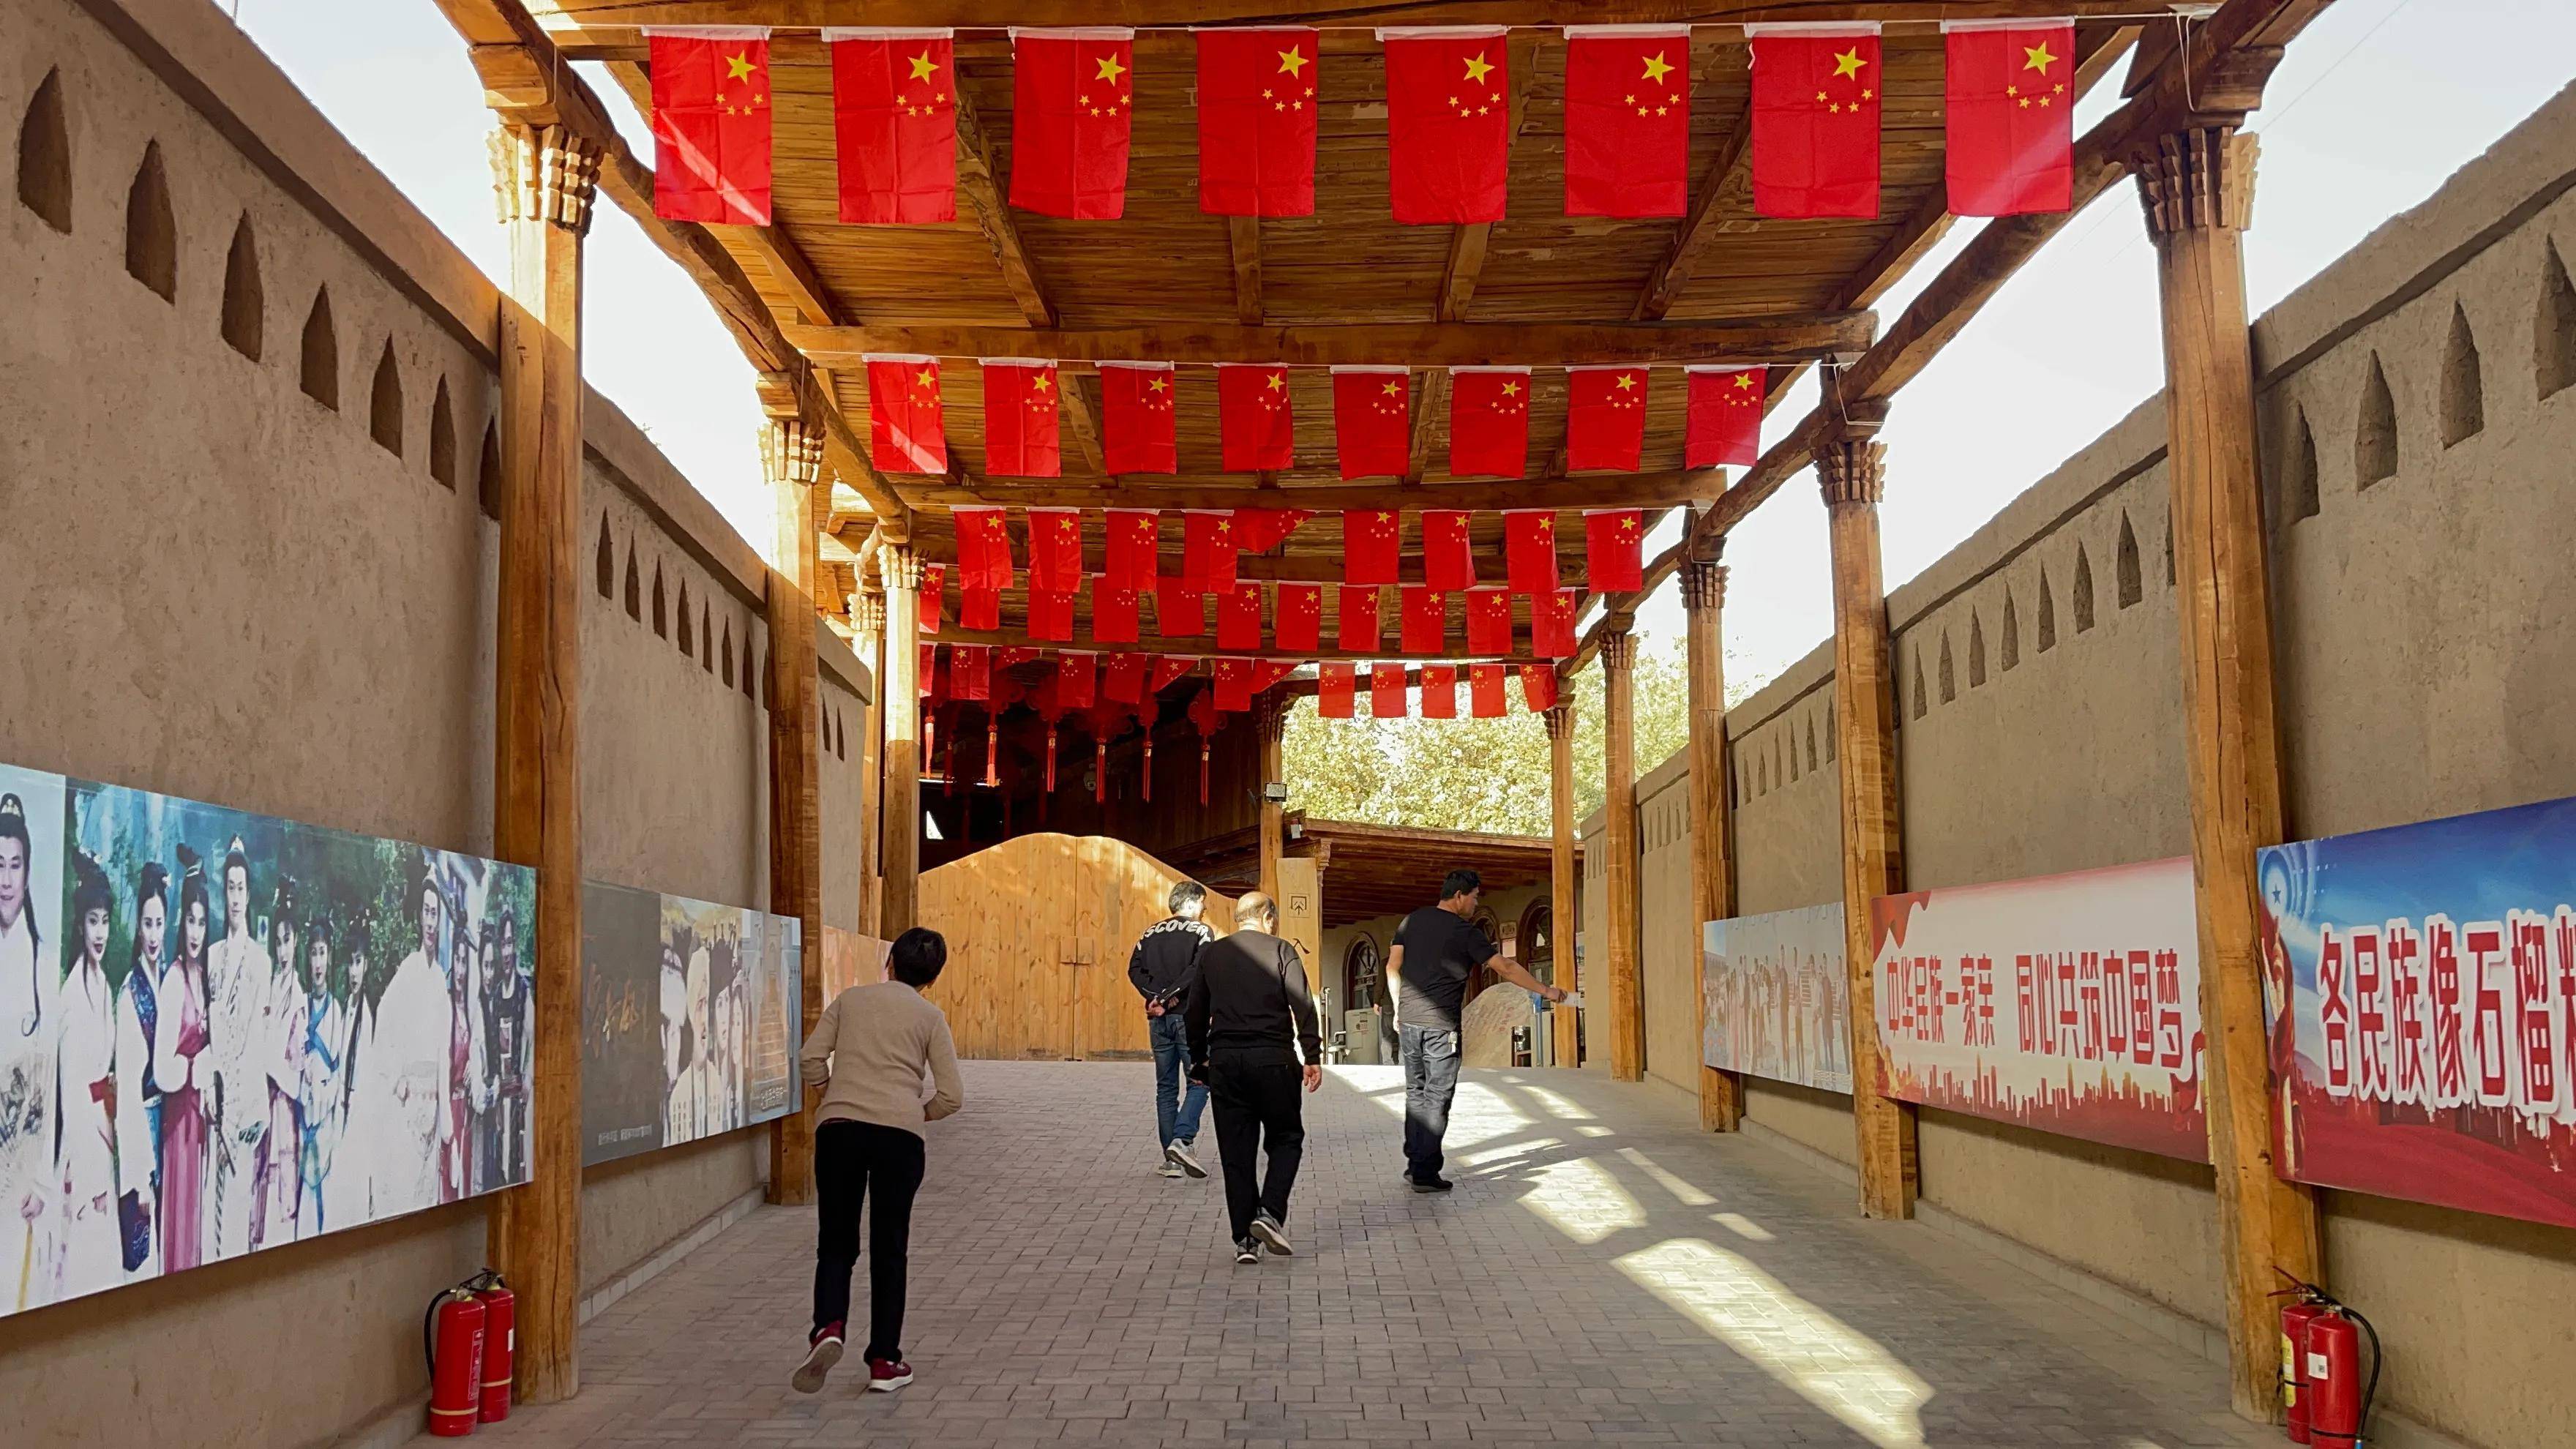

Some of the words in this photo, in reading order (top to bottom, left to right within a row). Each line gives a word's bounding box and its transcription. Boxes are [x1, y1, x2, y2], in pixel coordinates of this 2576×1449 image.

[1887, 953, 1996, 1048] 中华民族一家亲
[2015, 948, 2184, 1068] 同心共筑中国梦
